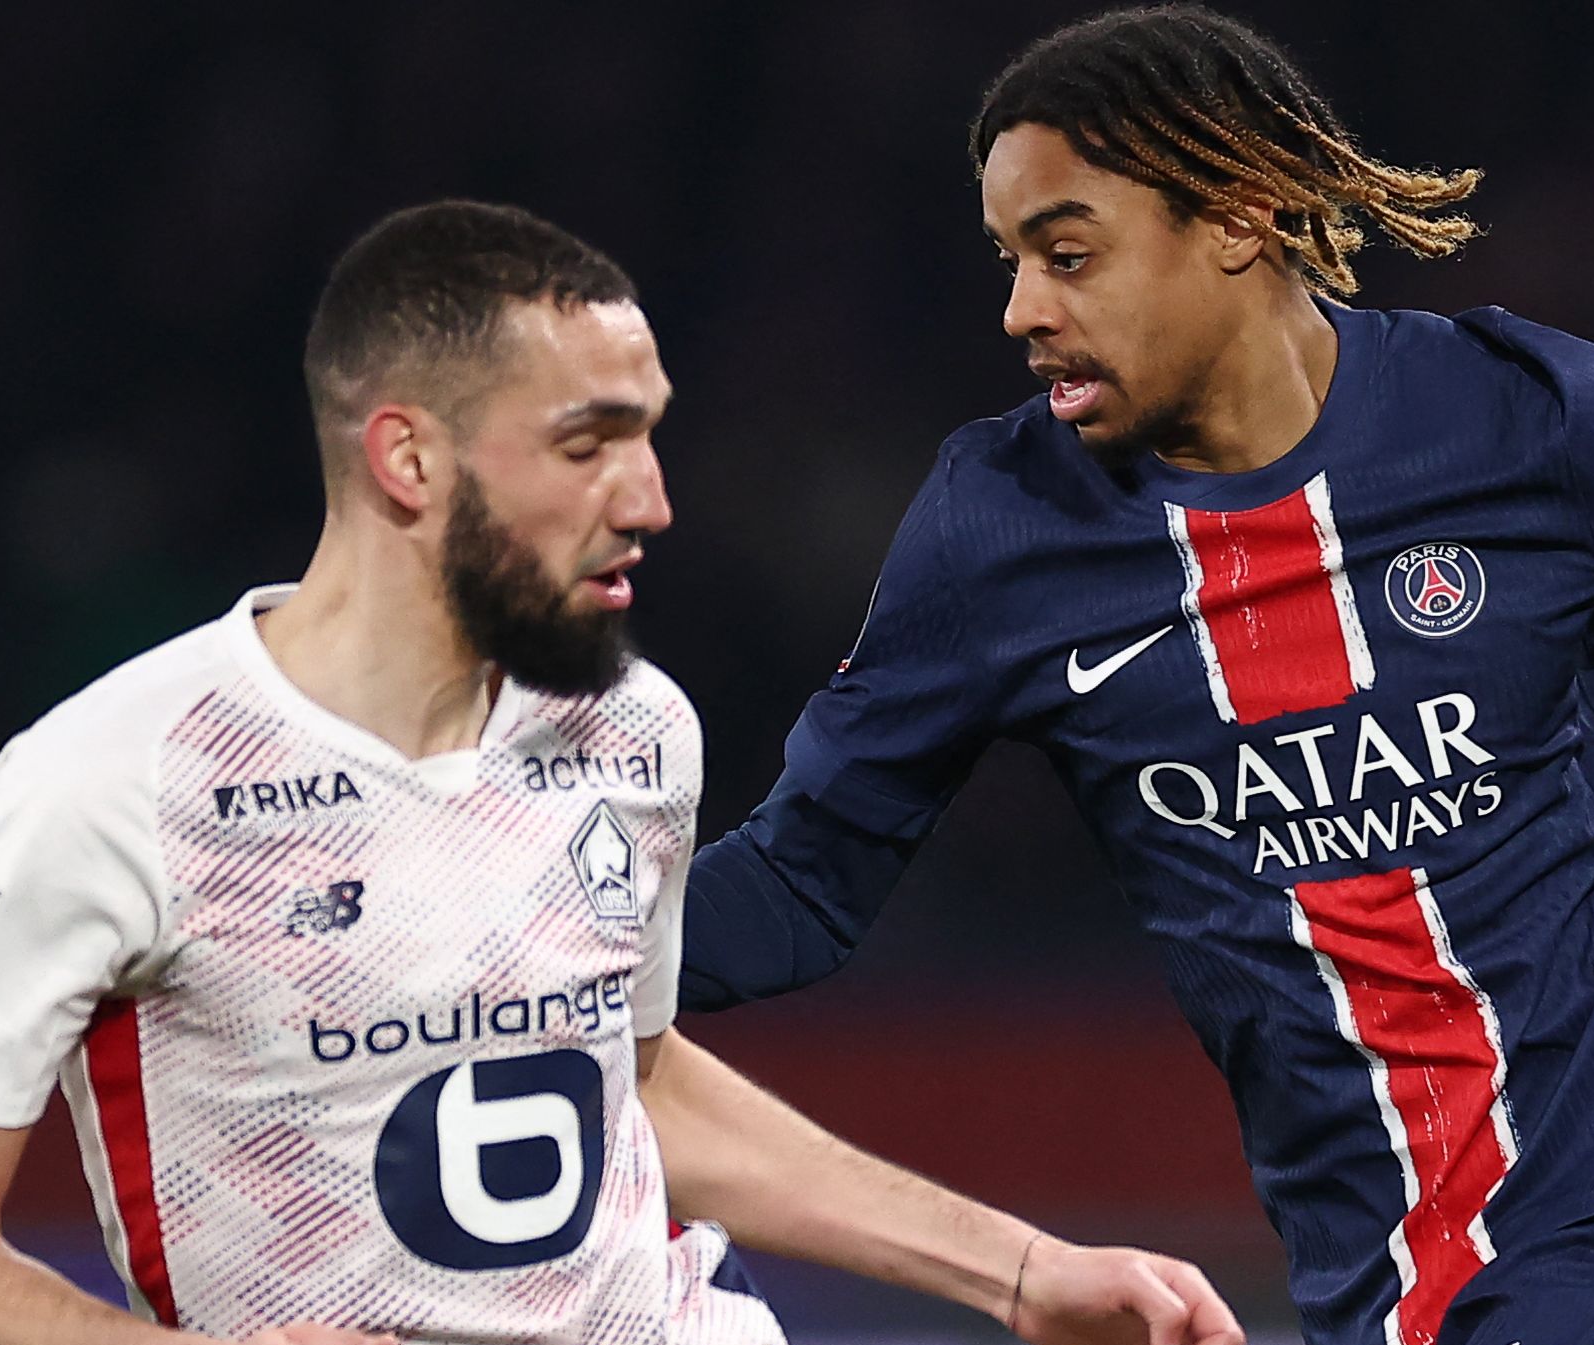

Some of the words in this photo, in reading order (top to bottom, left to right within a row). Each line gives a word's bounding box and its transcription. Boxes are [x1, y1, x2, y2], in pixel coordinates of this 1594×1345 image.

[1395, 545, 1460, 572] PARIS
[523, 743, 663, 793] actual
[1138, 692, 1497, 840] QATAR
[1252, 770, 1503, 875] AIRWAYS
[309, 967, 632, 1063] boulange
